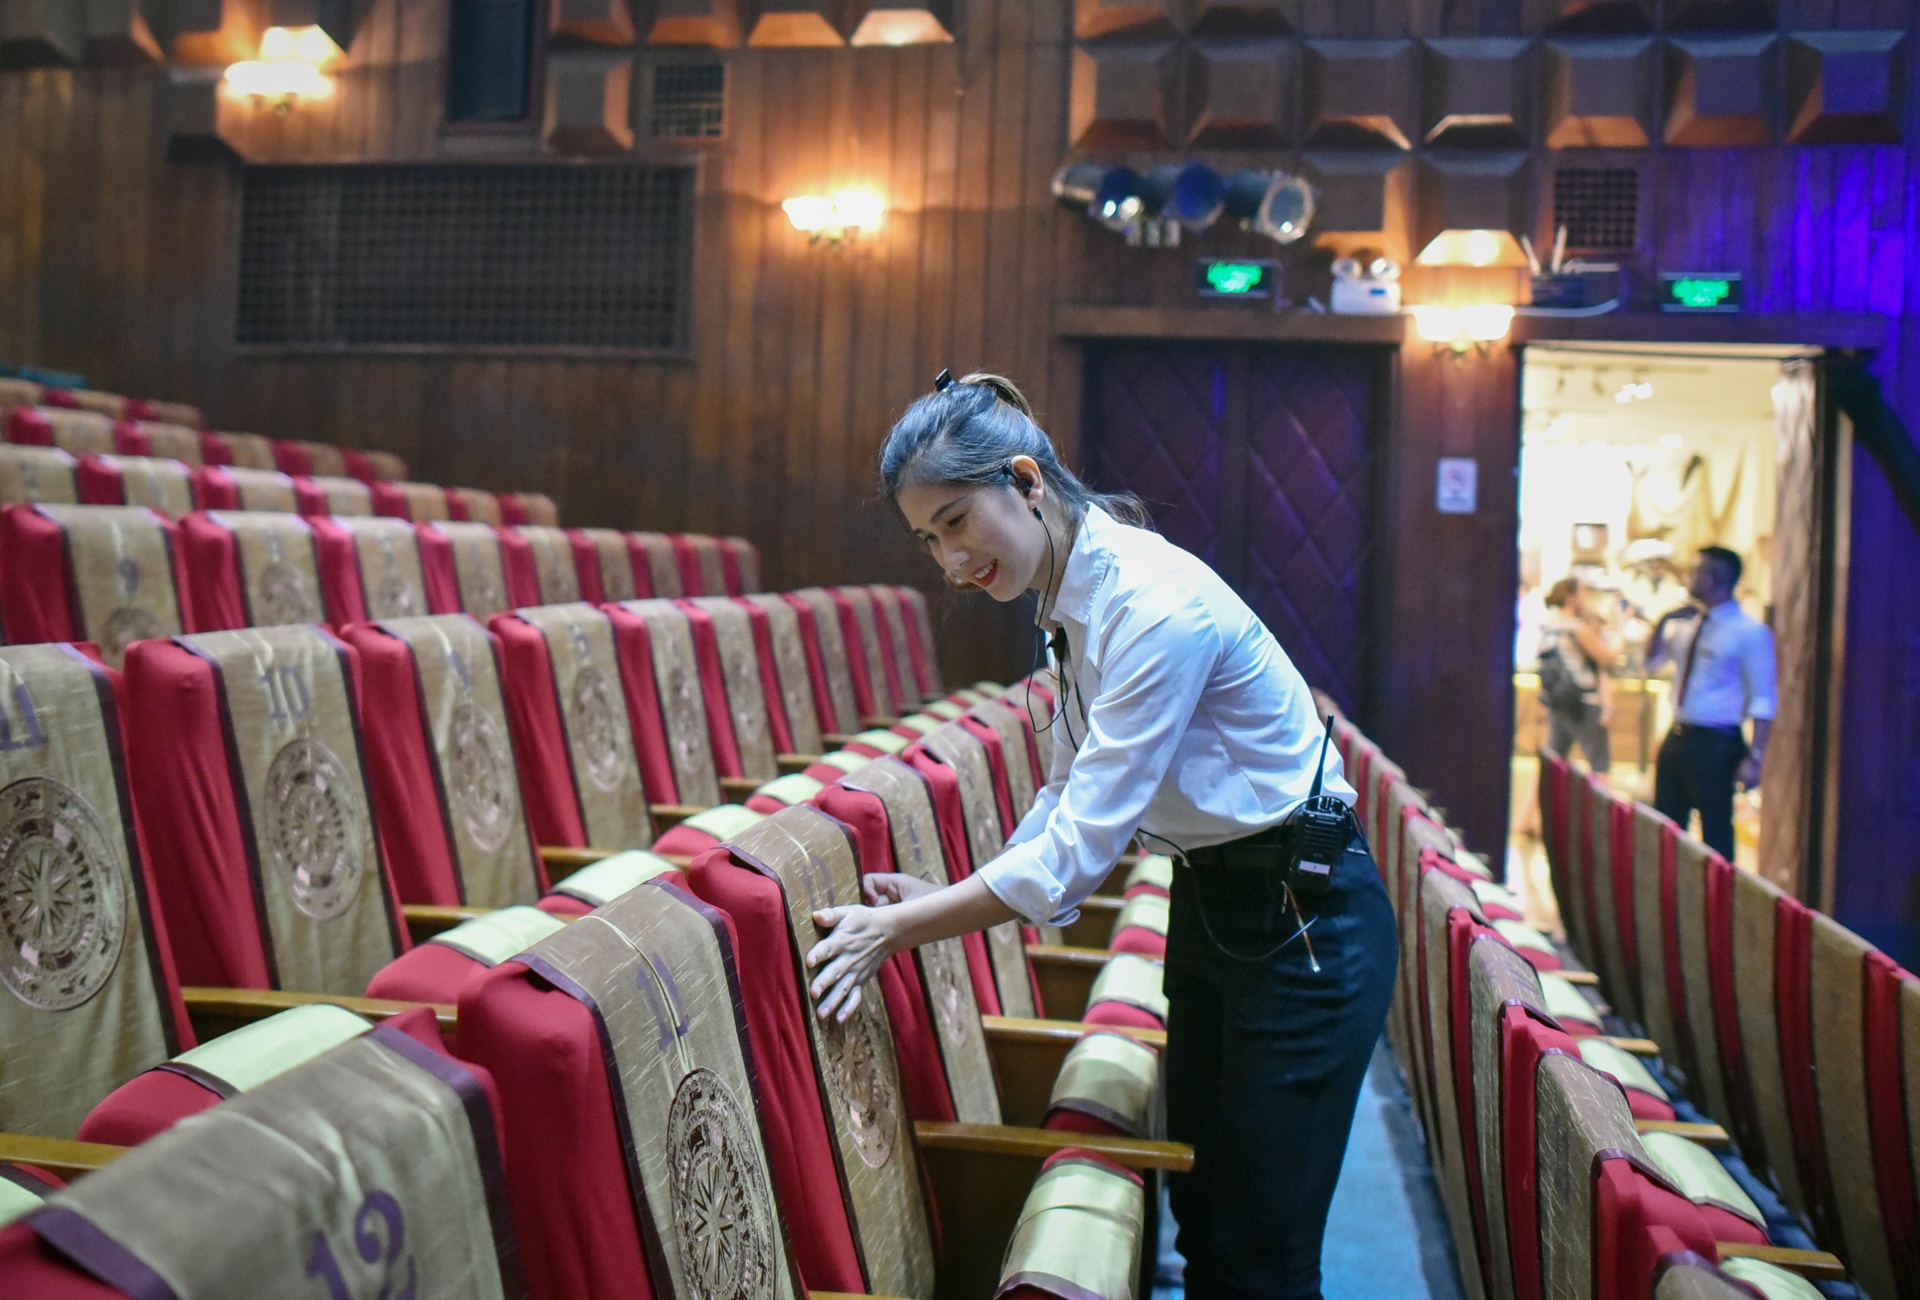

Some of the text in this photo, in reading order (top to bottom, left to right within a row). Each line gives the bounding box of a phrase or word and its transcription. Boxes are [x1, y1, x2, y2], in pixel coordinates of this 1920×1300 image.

[258, 665, 310, 720] 10
[635, 951, 690, 1051] 11
[305, 1189, 417, 1300] 12
